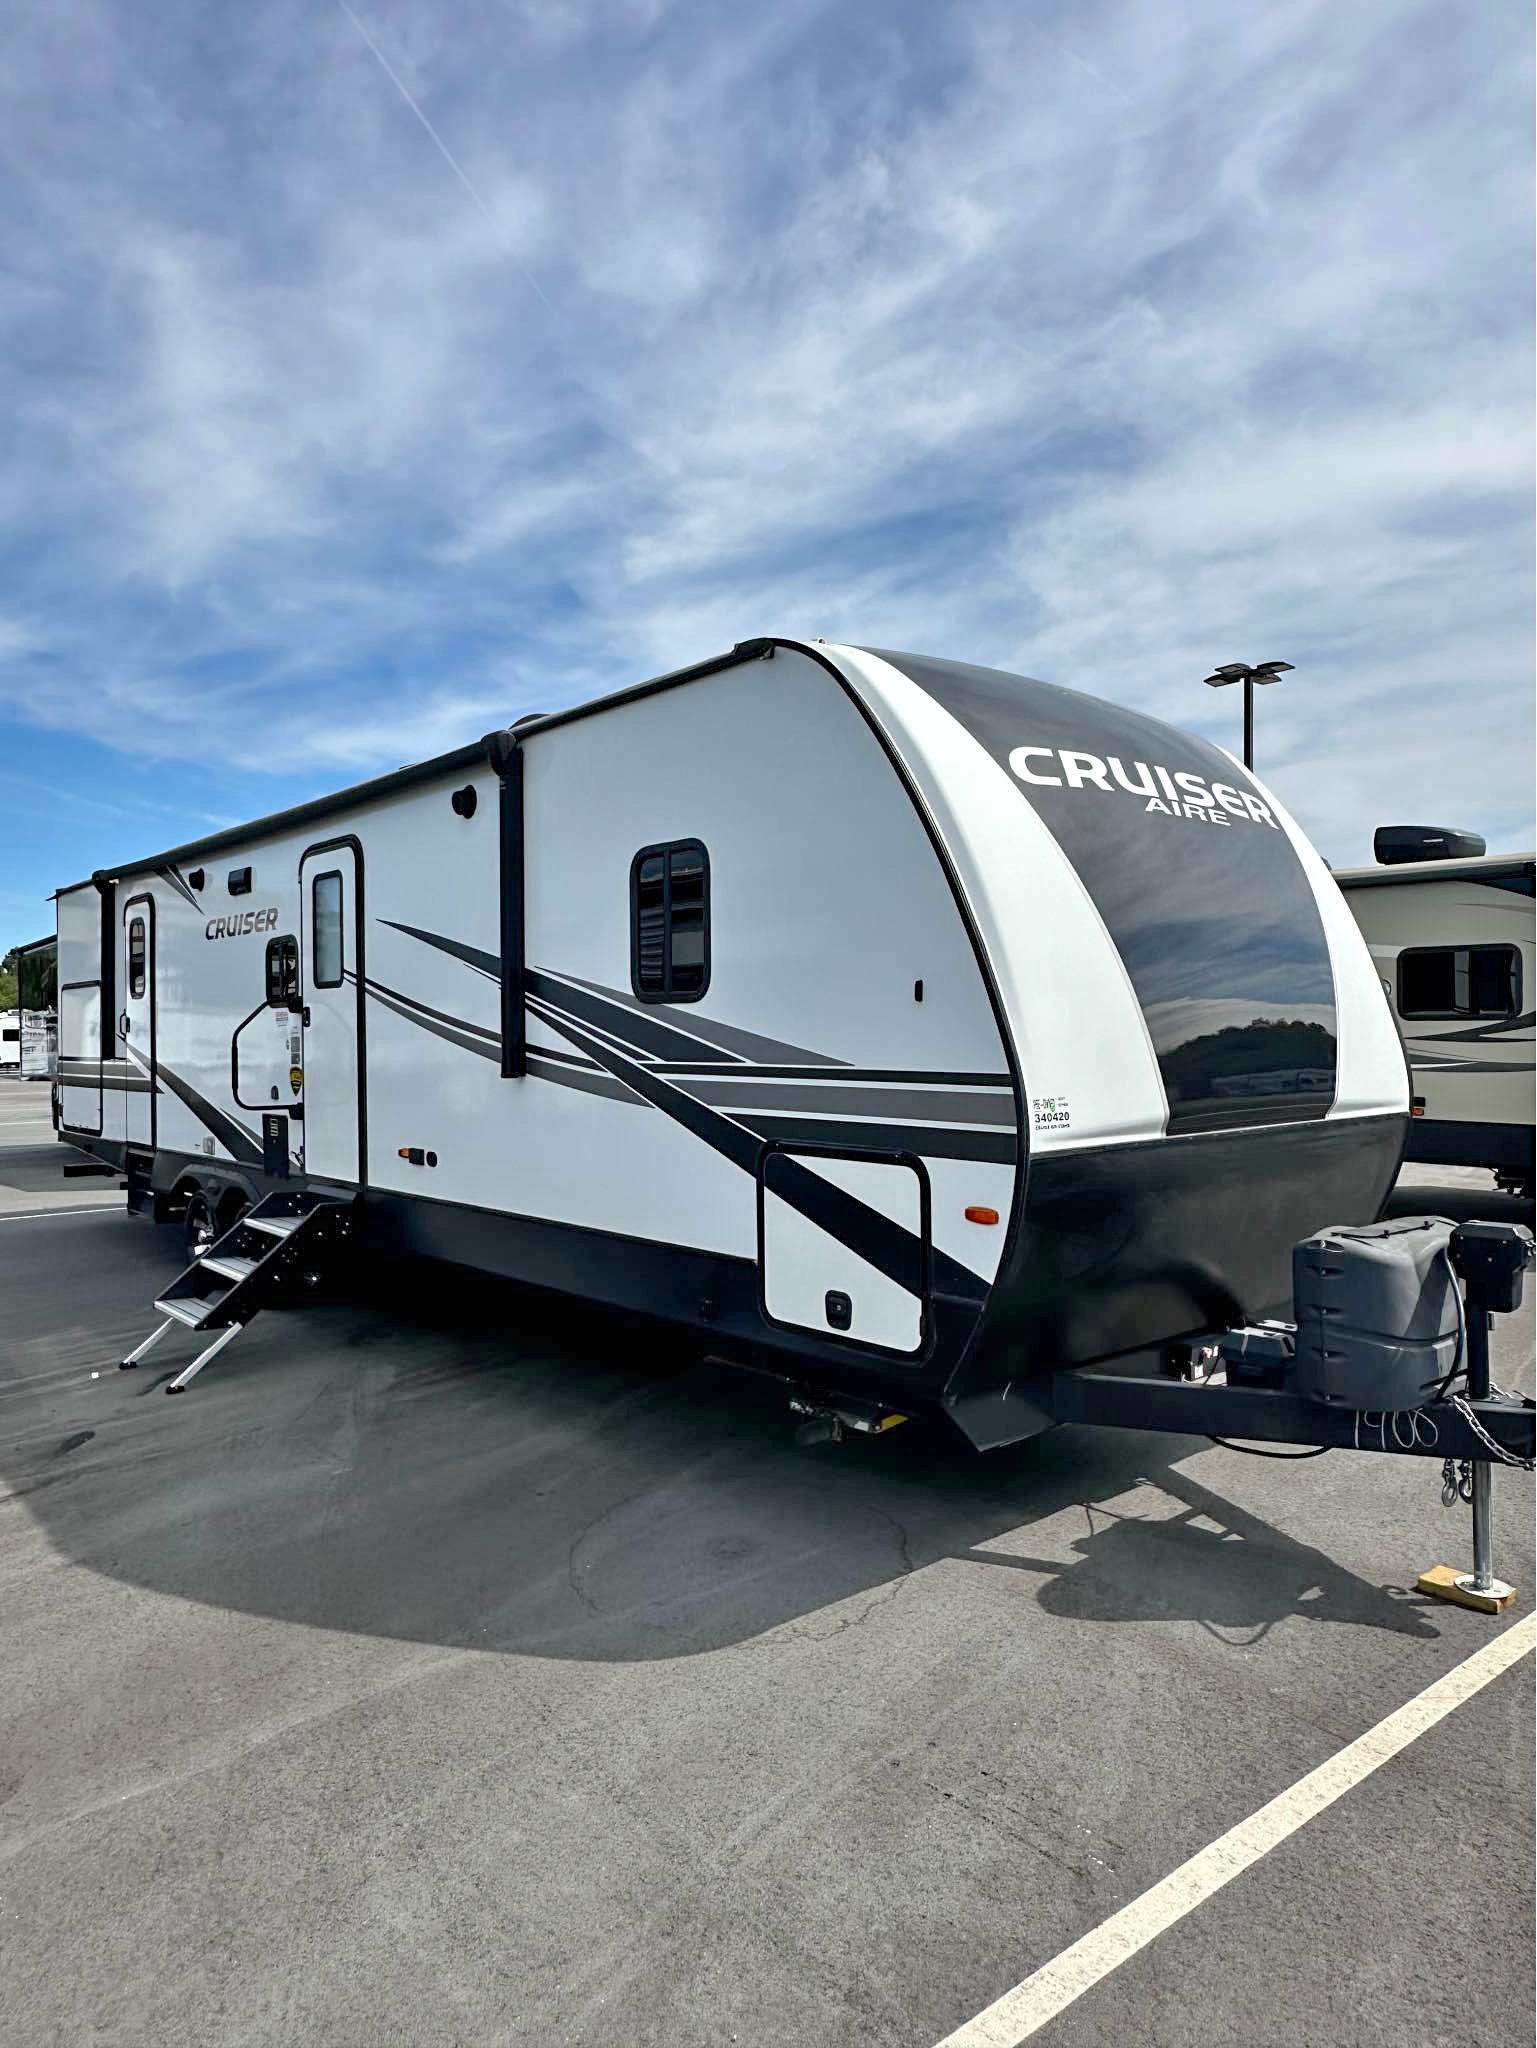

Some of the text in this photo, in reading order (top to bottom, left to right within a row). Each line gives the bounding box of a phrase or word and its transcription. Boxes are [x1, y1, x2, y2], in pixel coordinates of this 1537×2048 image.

[1009, 746, 1279, 829] CRUISER
[1145, 798, 1231, 826] AIRE
[205, 907, 278, 940] CRUISER
[1034, 1112, 1070, 1123] 340420
